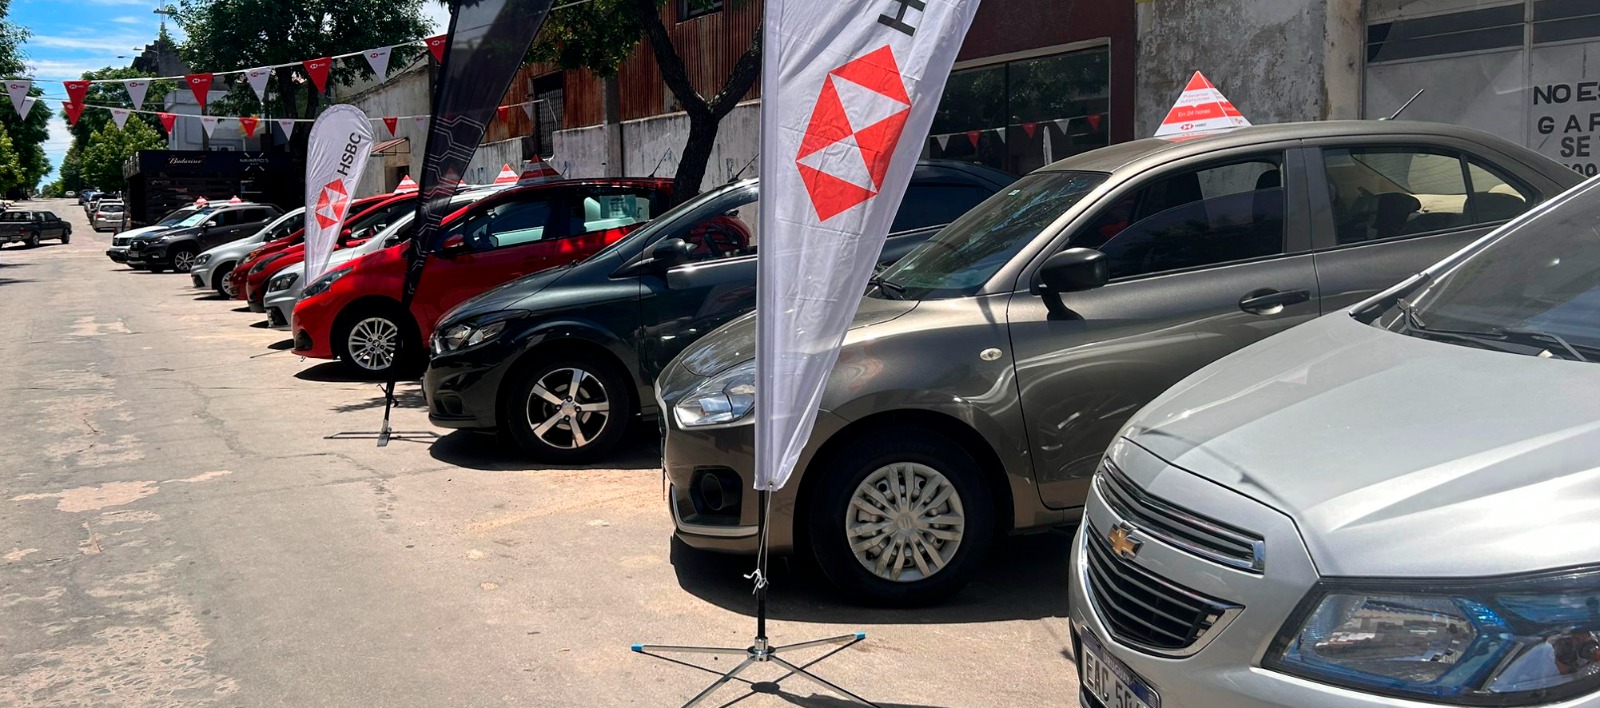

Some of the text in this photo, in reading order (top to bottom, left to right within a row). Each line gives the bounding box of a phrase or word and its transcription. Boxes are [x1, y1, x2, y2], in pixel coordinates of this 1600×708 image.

[1533, 82, 1600, 105] NO E
[337, 132, 361, 176] HSBC
[1560, 135, 1591, 157] SE
[1086, 649, 1110, 702] EAC
